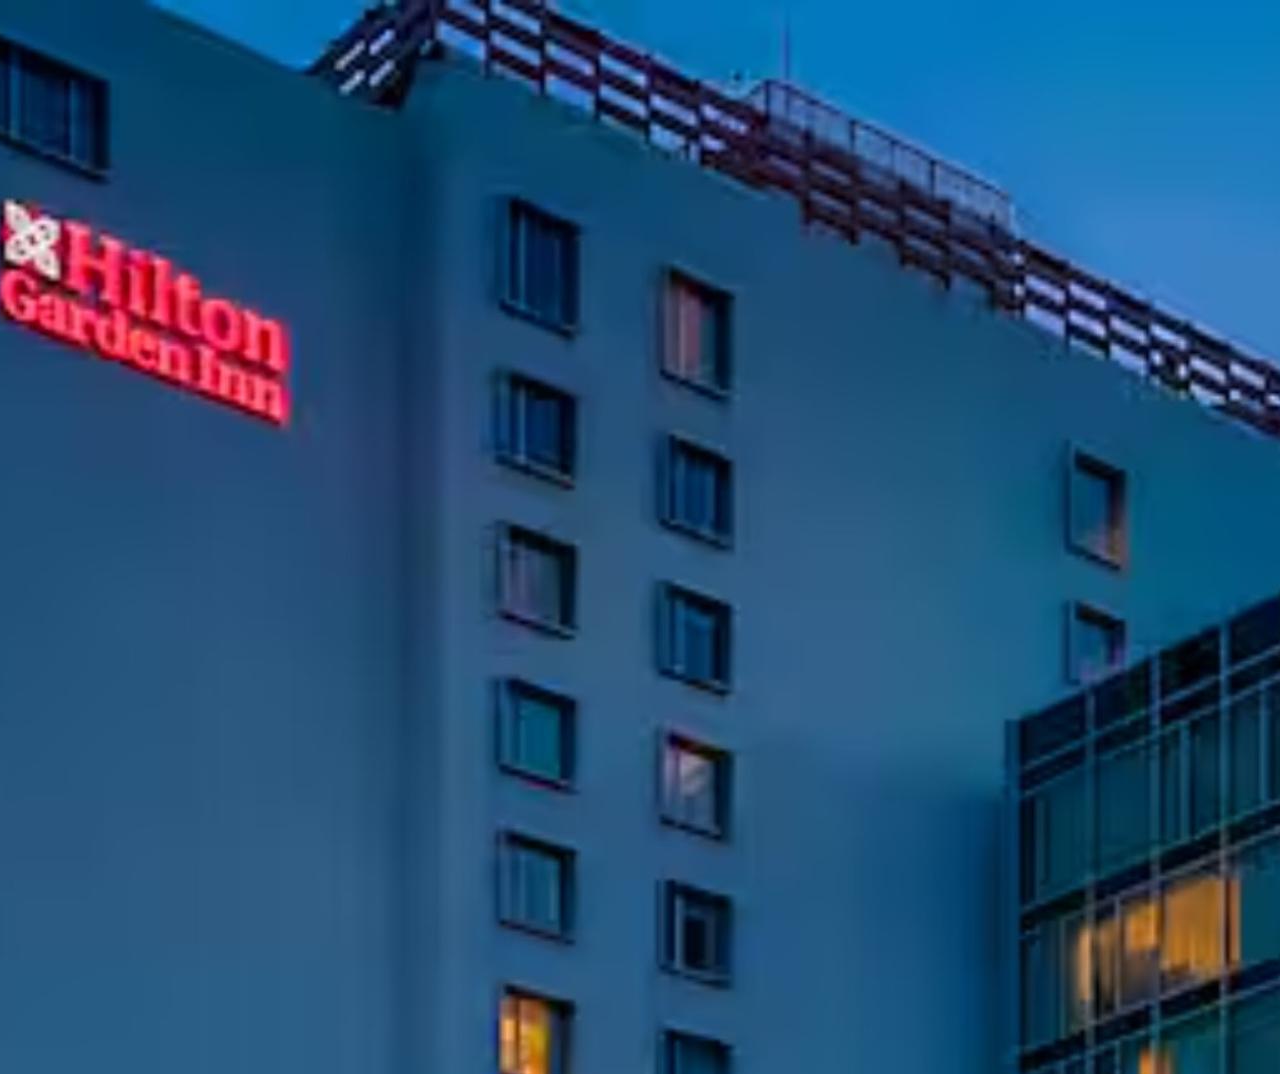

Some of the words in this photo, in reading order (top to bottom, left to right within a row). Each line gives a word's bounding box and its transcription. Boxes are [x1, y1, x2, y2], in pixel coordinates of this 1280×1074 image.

[0, 268, 192, 385] Garden
[197, 342, 289, 427] Inn
[63, 219, 289, 376] Hilton
